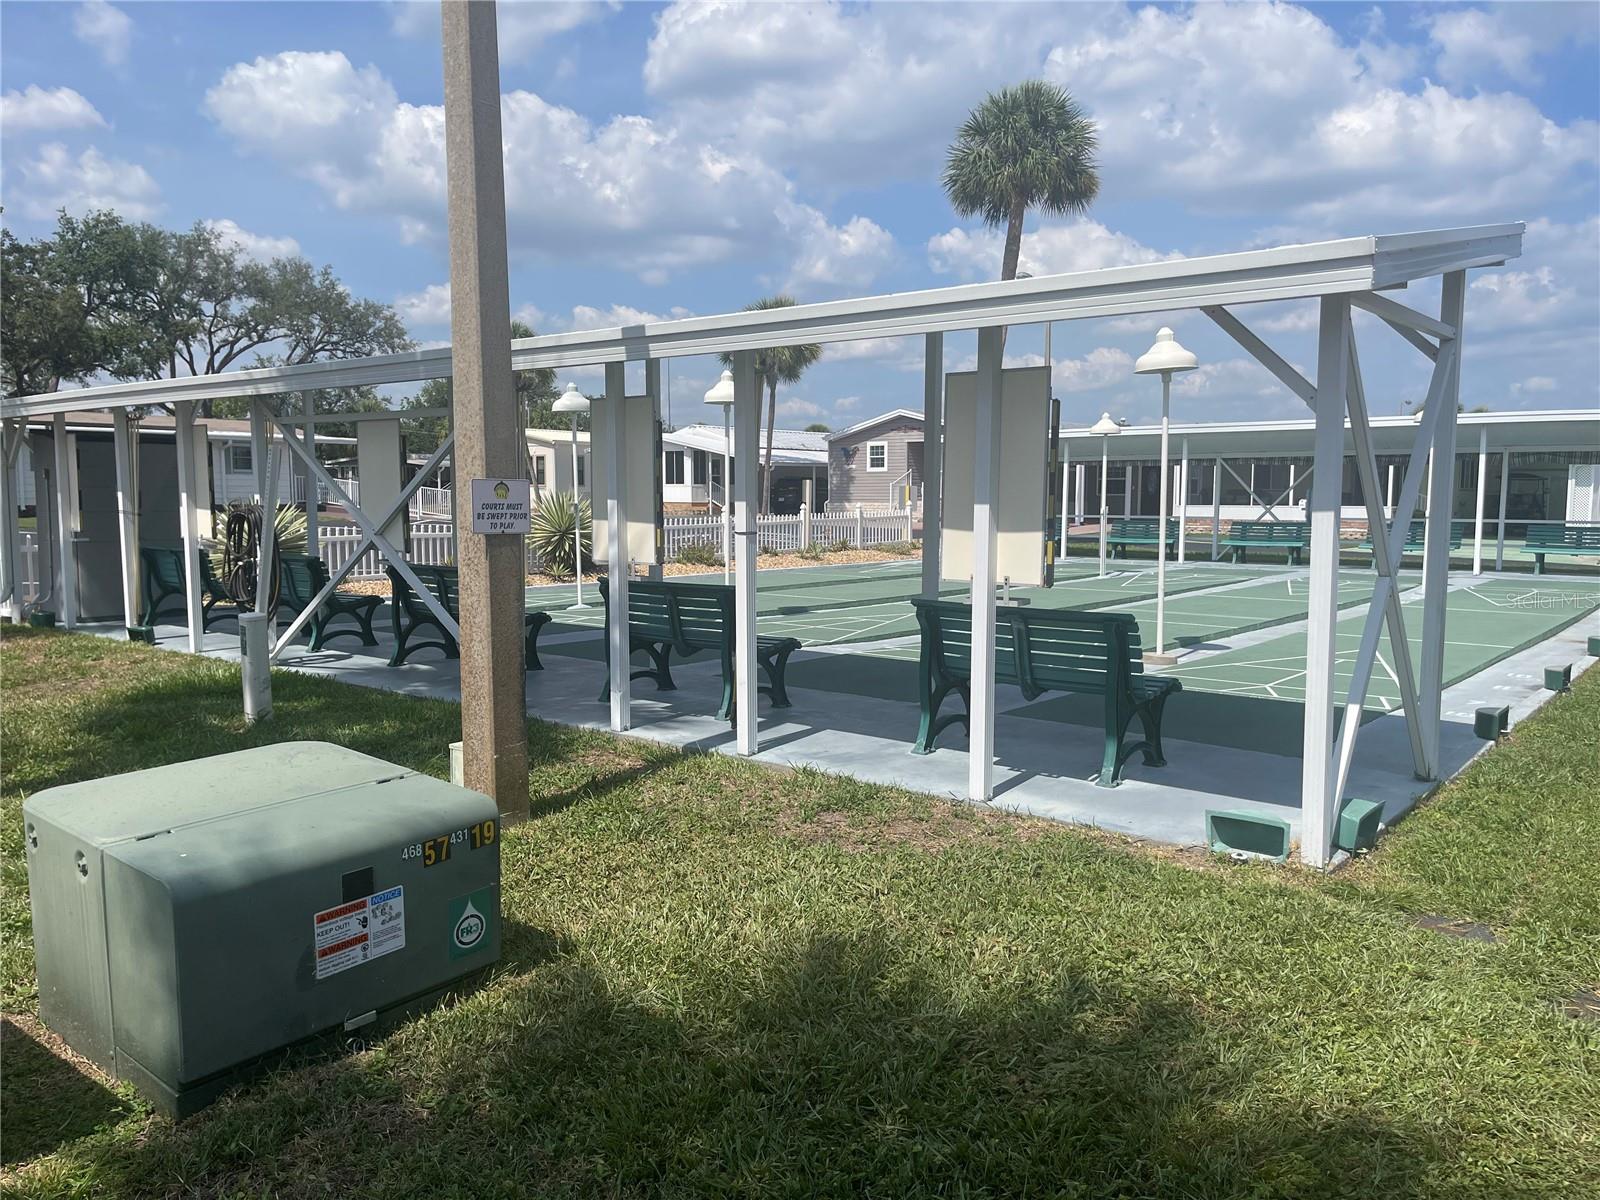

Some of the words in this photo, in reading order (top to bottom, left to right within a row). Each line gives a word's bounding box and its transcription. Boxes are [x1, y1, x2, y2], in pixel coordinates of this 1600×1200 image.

[481, 503, 505, 511] COURTS
[506, 503, 523, 511] MUST
[477, 512, 486, 520] BE
[486, 512, 508, 520] SWEPT
[509, 512, 528, 521] PRIOR
[490, 522, 498, 530] TO
[402, 844, 422, 860] 468
[424, 836, 449, 866] 57
[450, 828, 468, 845] 431
[471, 820, 495, 849] 19
[372, 889, 401, 905] NOTICE
[324, 901, 366, 919] WARNING
[316, 927, 334, 938] KEEP
[334, 921, 350, 932] OUT!
[327, 935, 368, 956] WARNING
